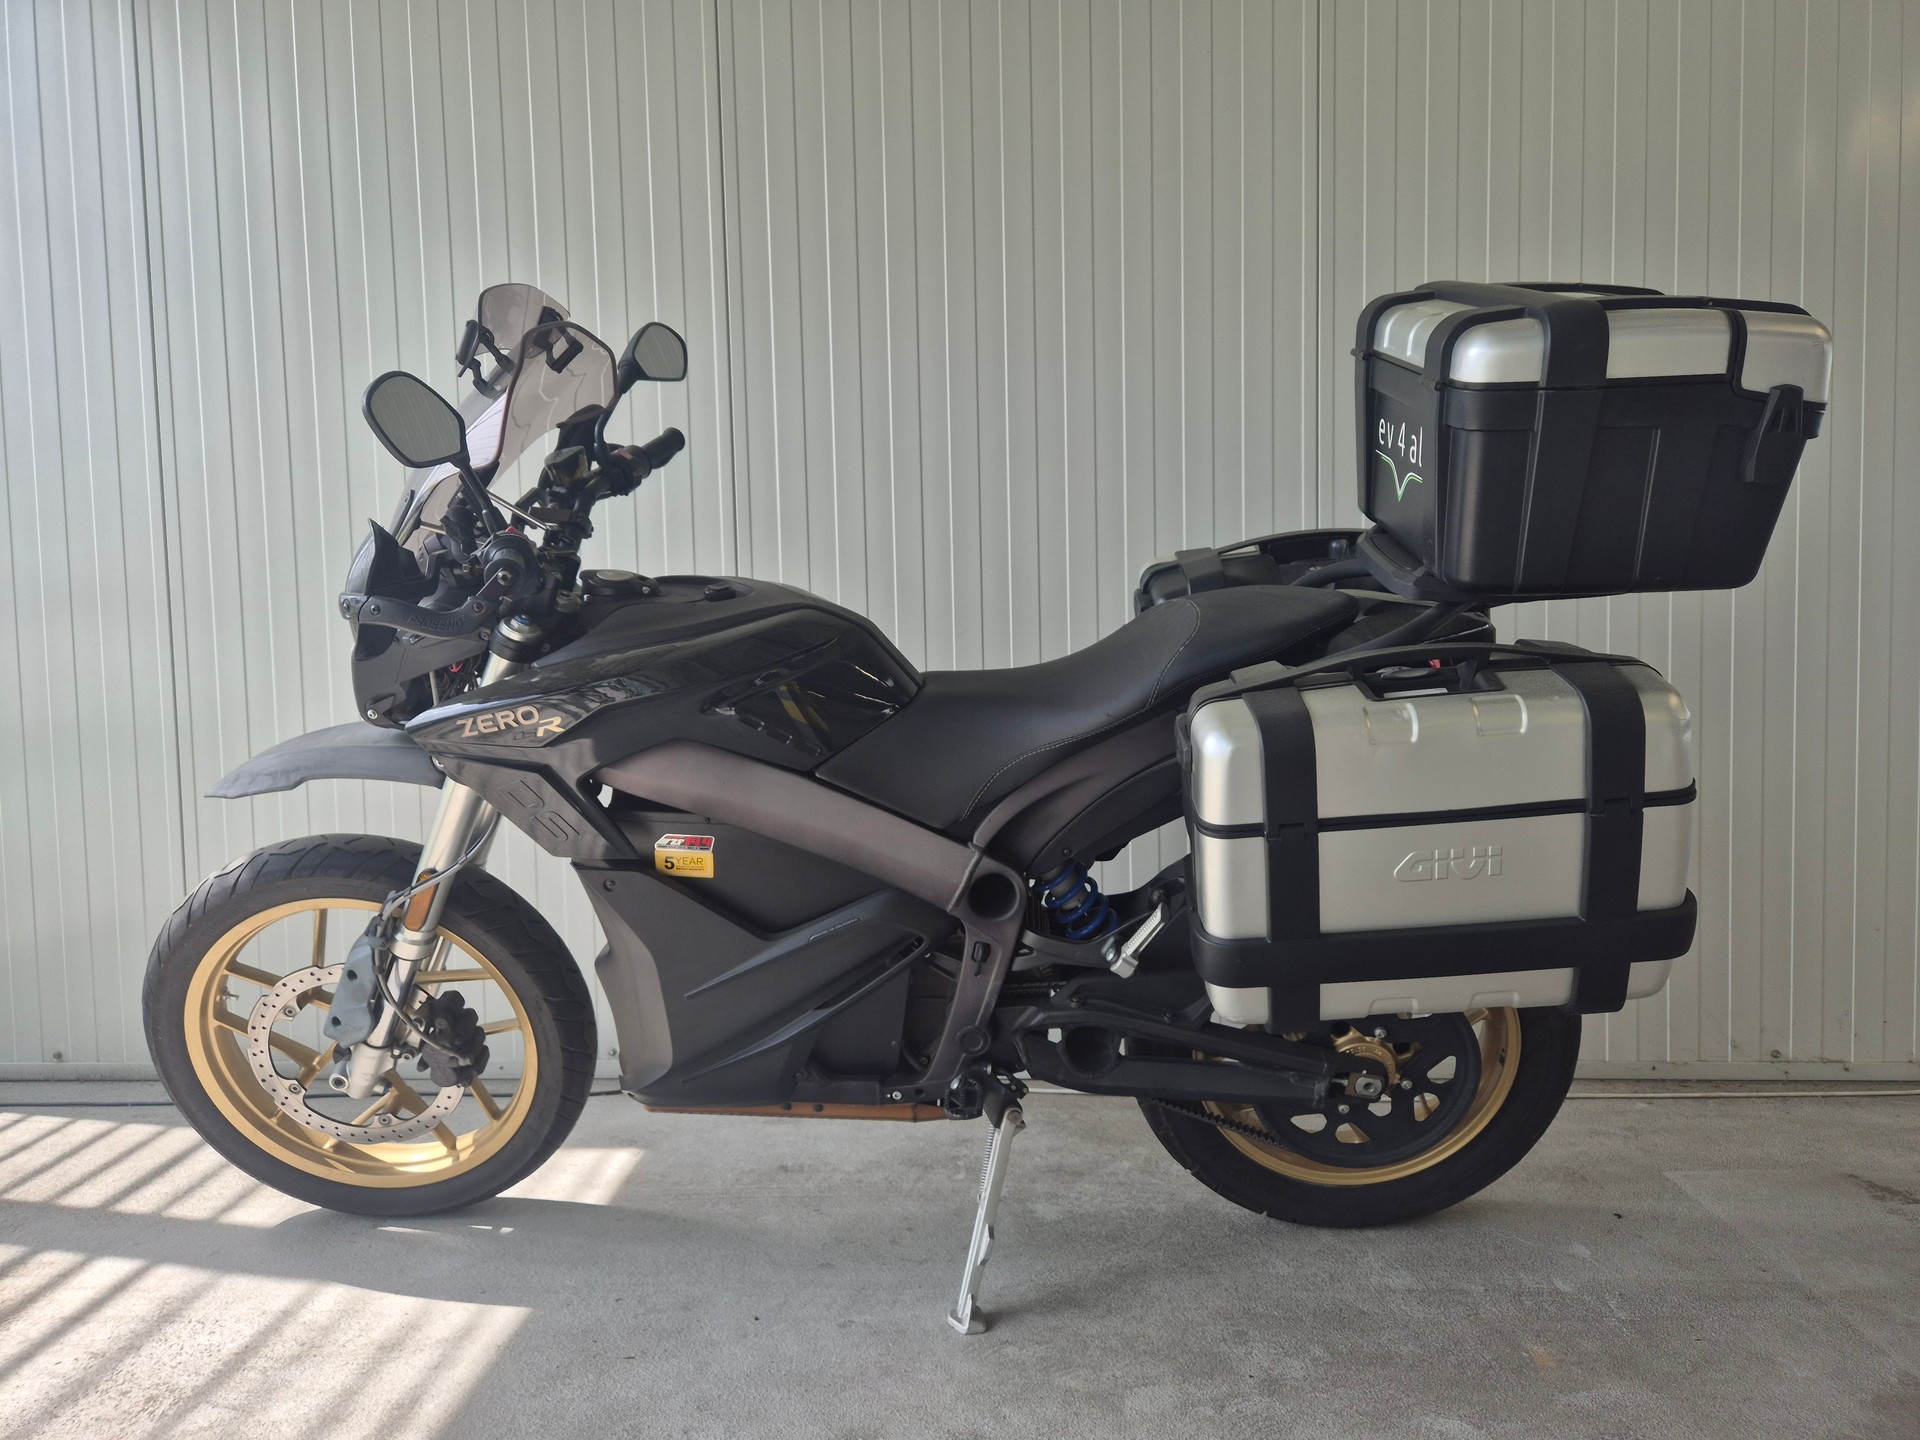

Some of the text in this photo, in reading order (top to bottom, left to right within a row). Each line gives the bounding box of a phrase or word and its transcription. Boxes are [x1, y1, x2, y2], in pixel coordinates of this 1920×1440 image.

[456, 705, 540, 738] ZERO
[663, 855, 704, 870] 5 YEAR
[1393, 846, 1503, 882] GIVI
